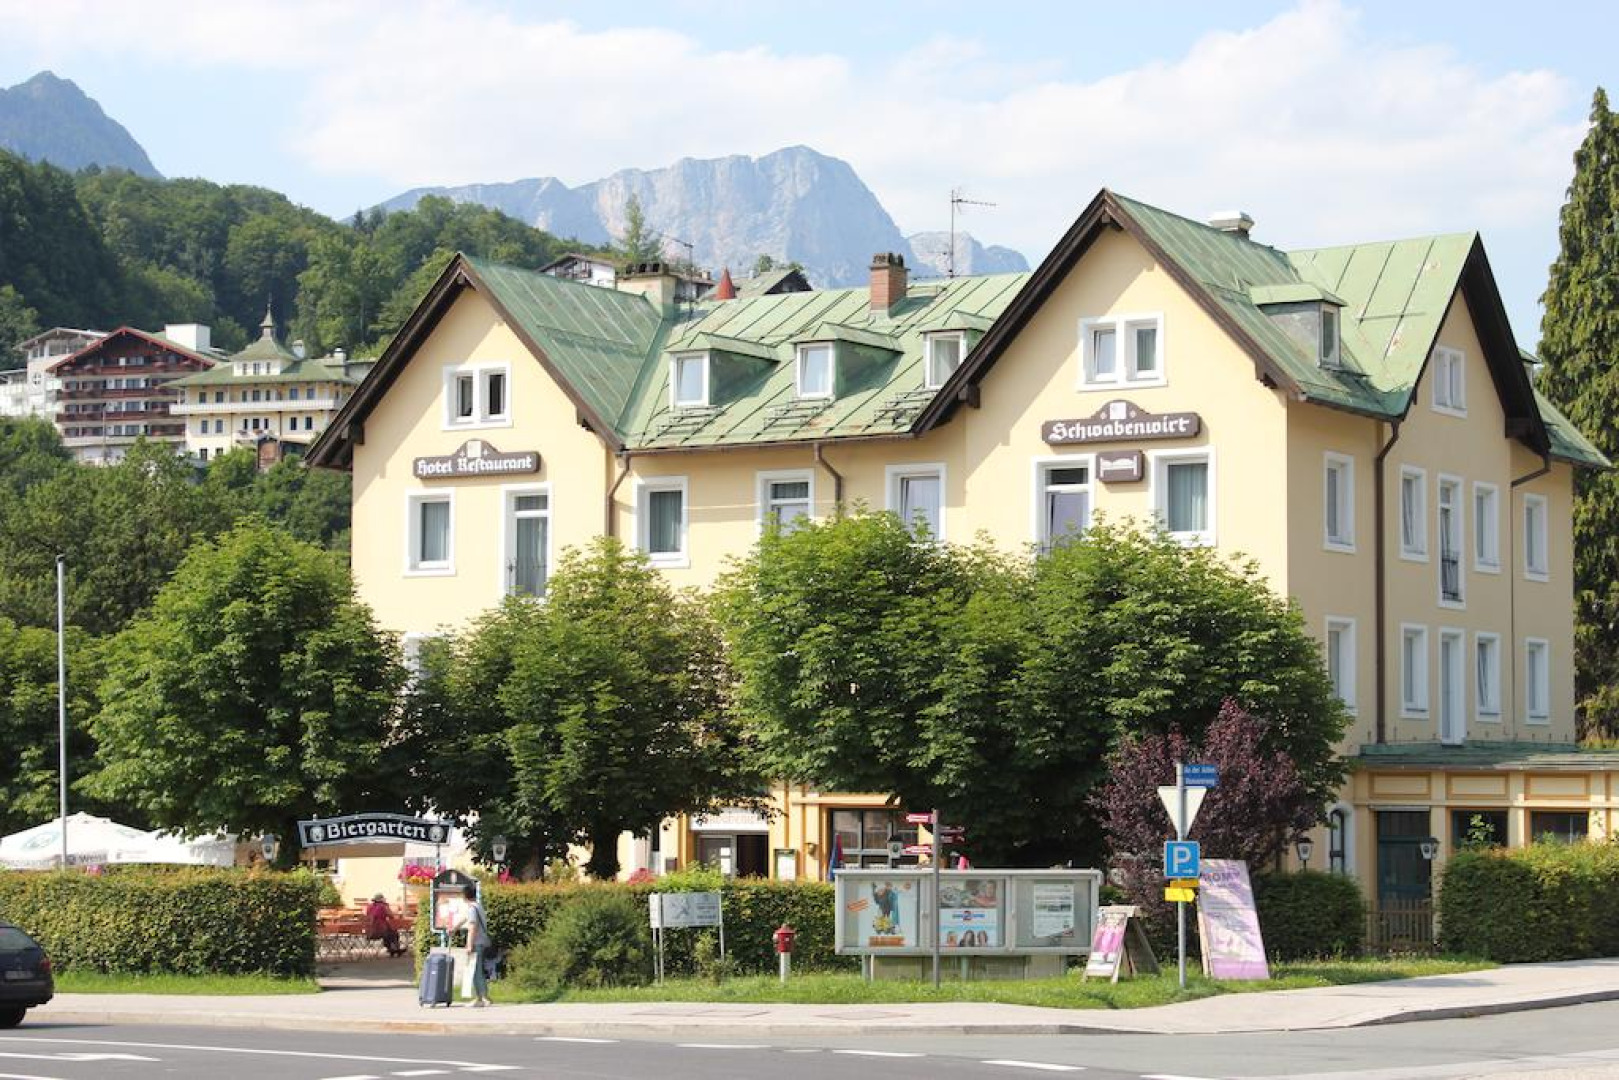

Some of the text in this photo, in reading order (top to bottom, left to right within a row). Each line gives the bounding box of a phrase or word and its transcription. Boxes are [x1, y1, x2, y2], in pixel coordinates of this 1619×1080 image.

[1048, 415, 1190, 441] Schwabenwirt
[417, 455, 532, 475] Hotel Restaurant
[327, 821, 427, 839] Biergarten
[1172, 845, 1192, 874] P
